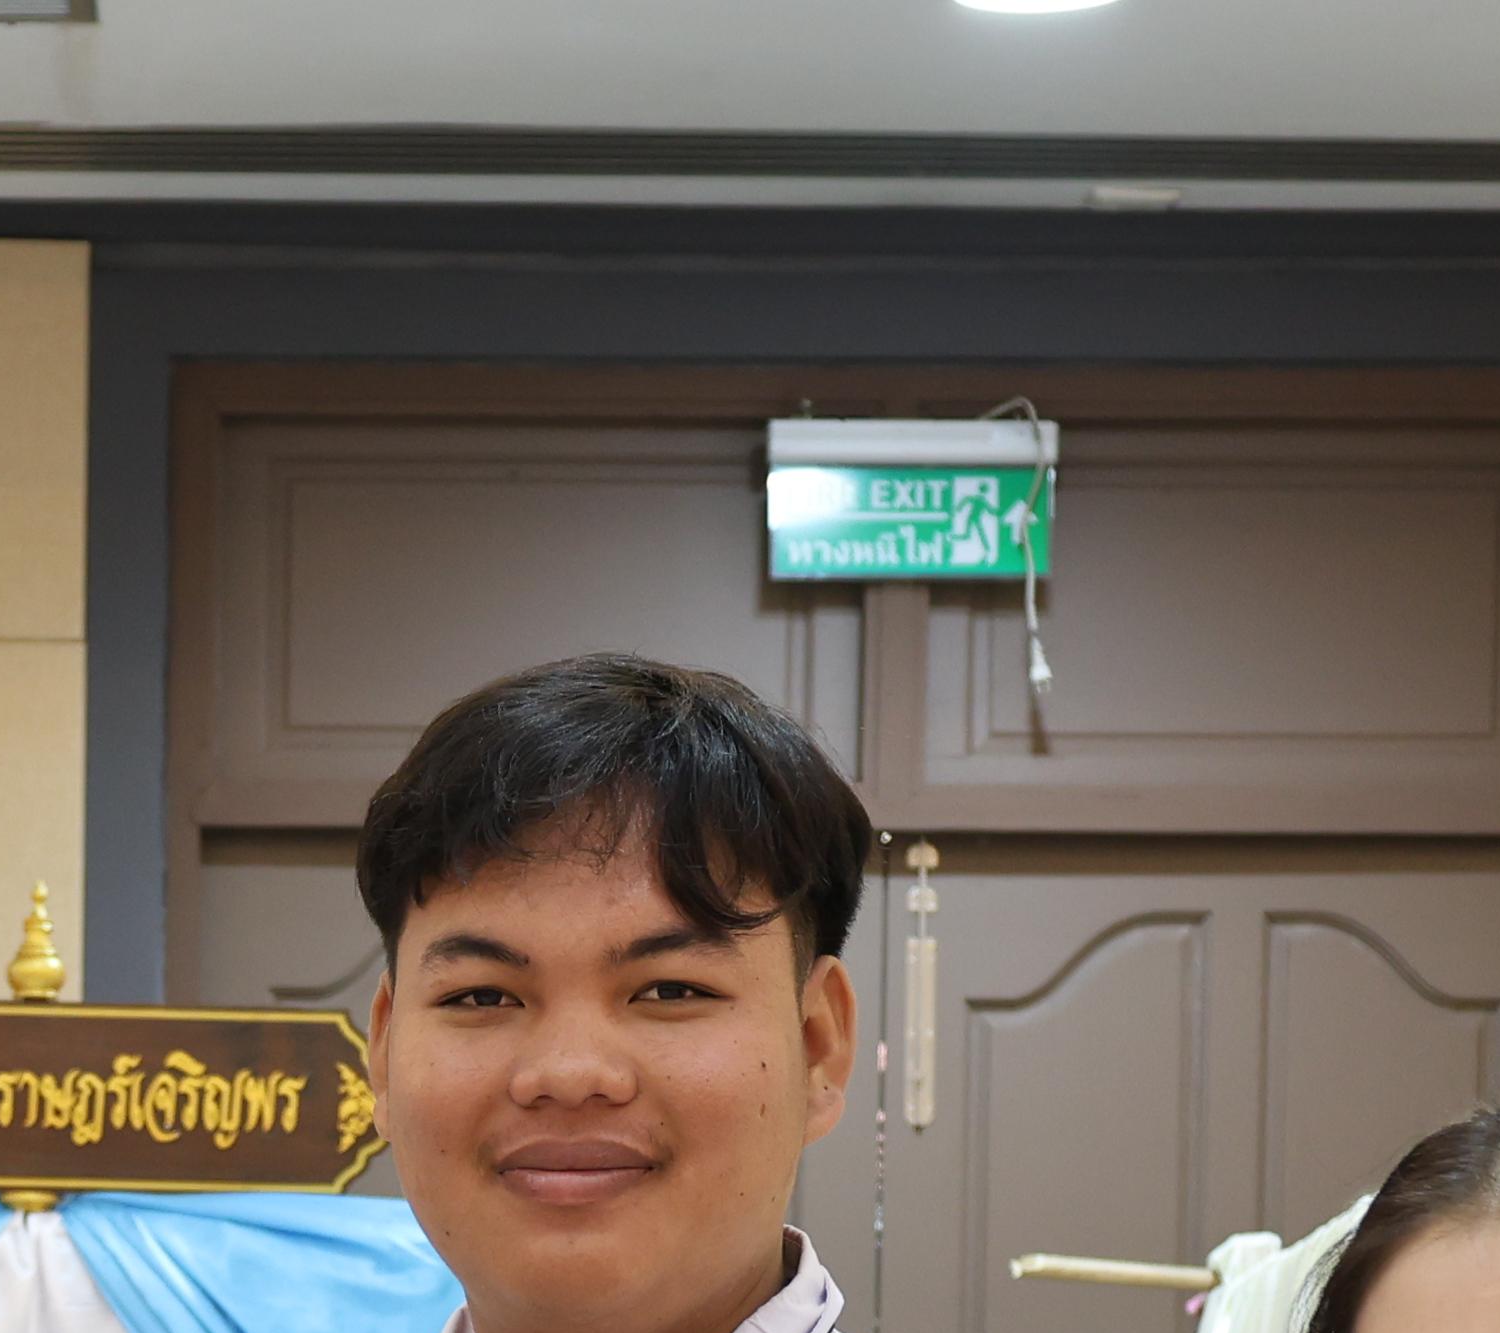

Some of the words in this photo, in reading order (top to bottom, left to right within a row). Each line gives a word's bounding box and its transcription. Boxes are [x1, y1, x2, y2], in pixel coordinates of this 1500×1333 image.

[870, 479, 950, 509] EXIT
[788, 523, 946, 566] ทางหนีไฟ
